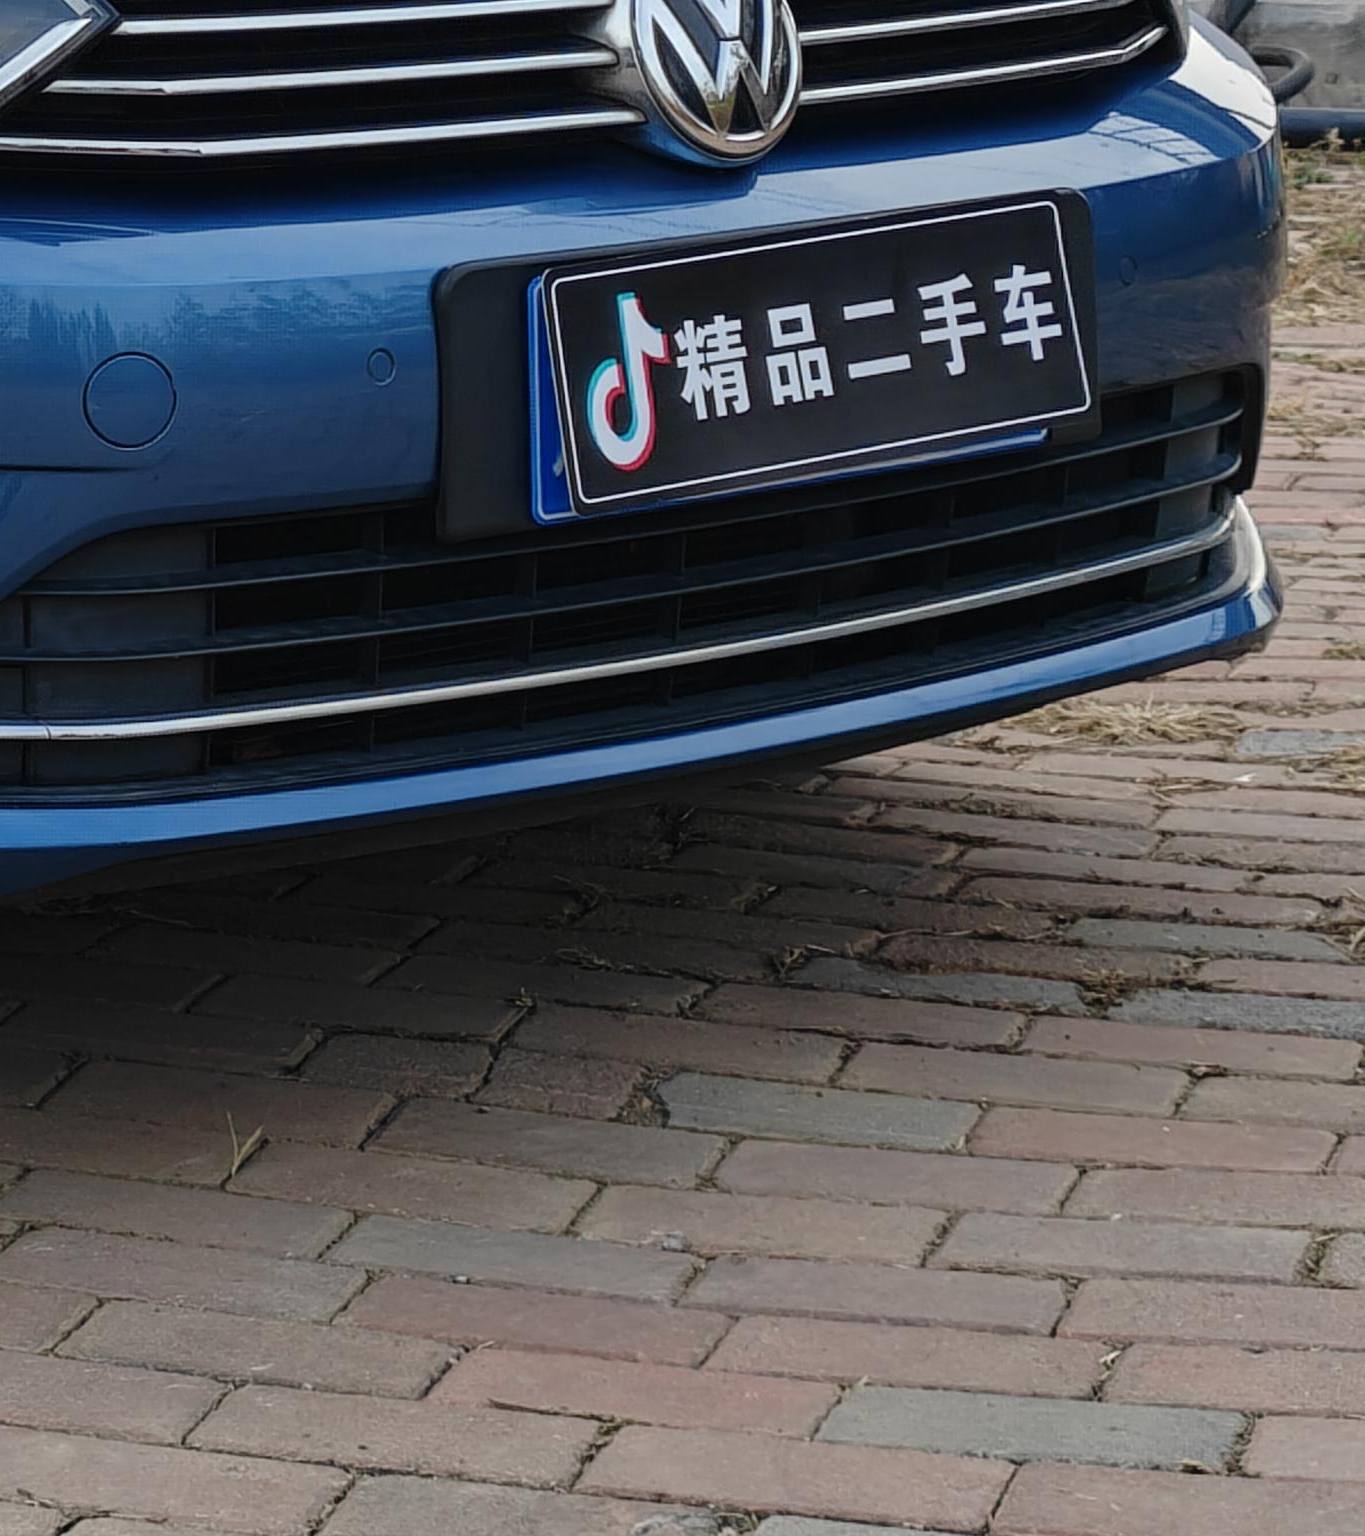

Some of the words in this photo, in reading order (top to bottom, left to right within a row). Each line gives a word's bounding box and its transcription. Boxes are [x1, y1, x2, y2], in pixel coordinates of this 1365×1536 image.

[673, 264, 1064, 422] 精品二手车
